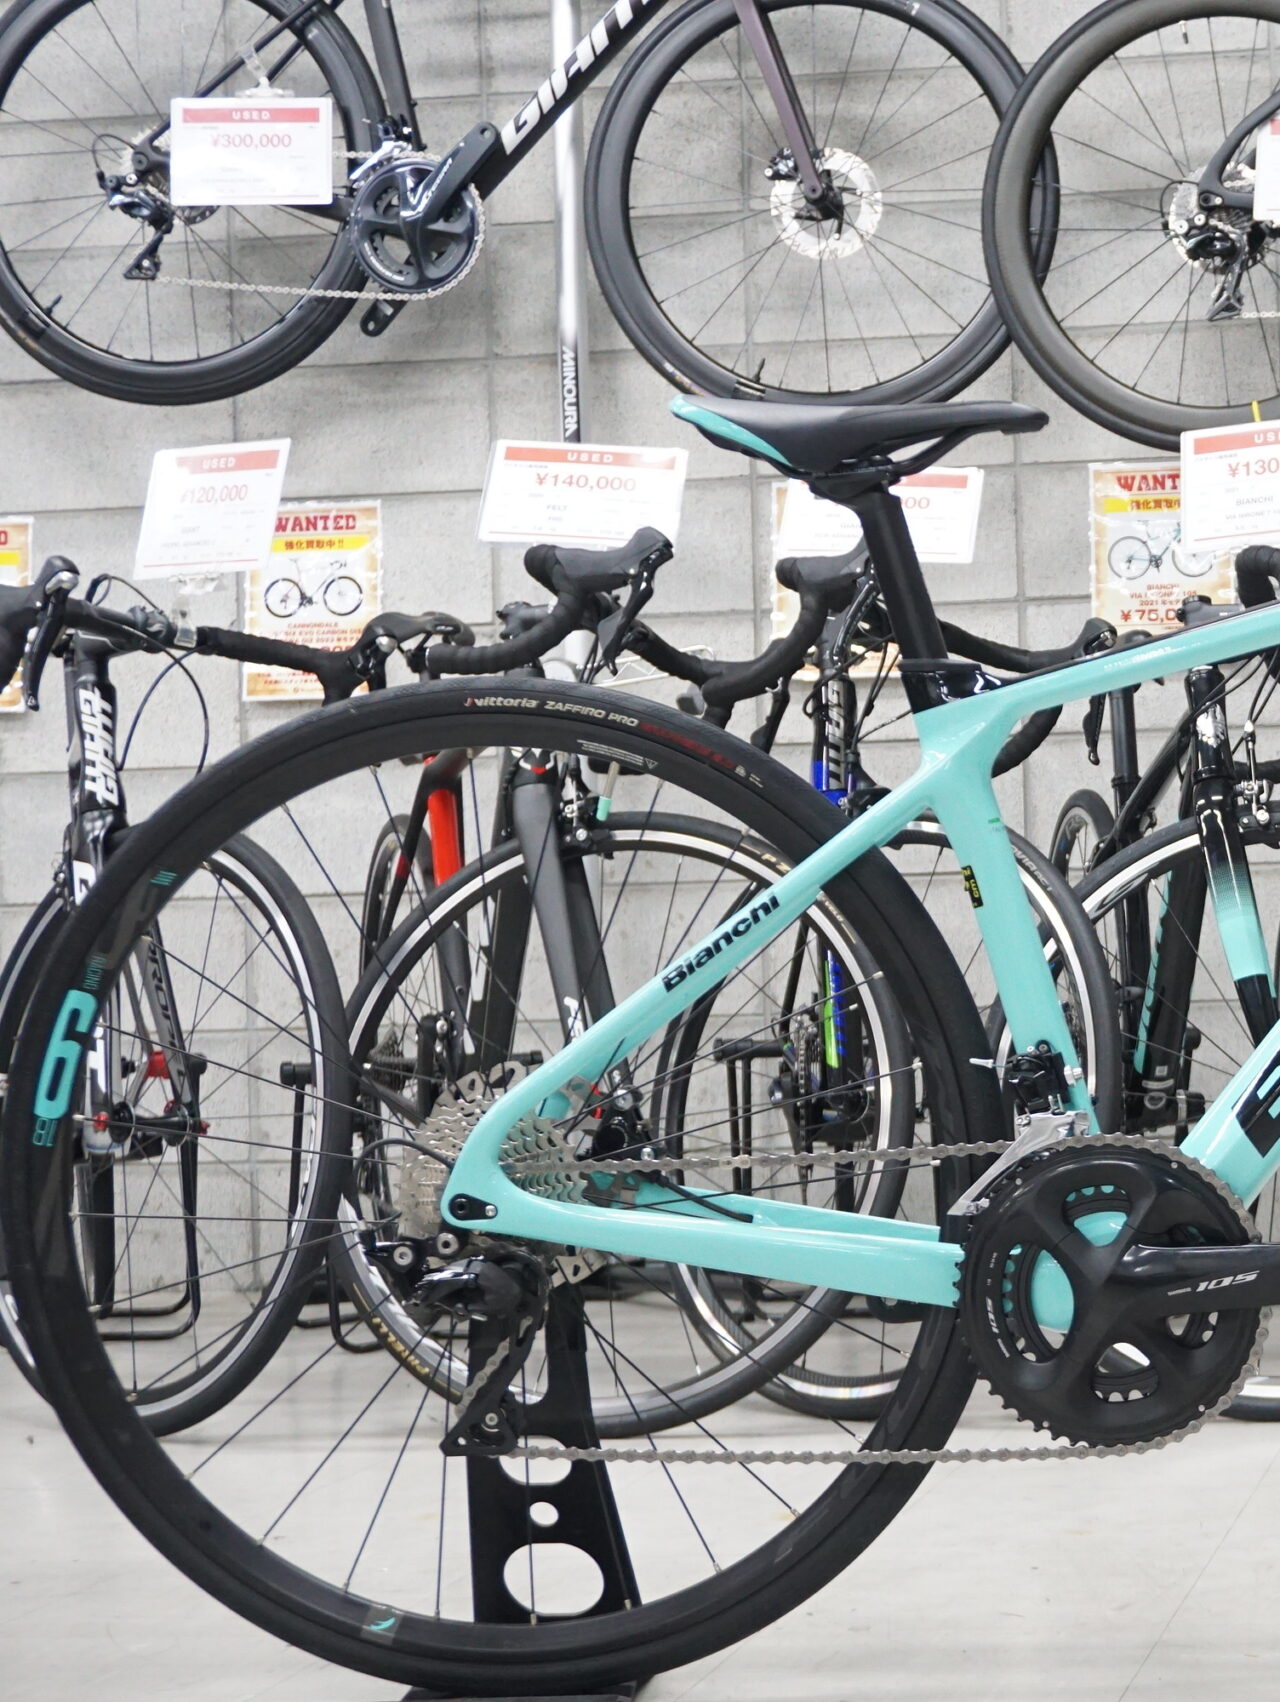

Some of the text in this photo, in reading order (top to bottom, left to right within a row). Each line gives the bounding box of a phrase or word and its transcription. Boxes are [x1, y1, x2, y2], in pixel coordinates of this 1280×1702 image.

[500, 0, 652, 156] GIAN
[231, 110, 271, 120] USED
[211, 134, 292, 150] ¥300,000
[562, 346, 578, 437] MINOURA
[202, 457, 237, 470] USED
[567, 452, 614, 464] USED
[536, 472, 636, 492] ¥140,000
[1116, 474, 1180, 492] WANT
[1235, 495, 1274, 506] BIANCHI
[275, 514, 357, 532] WANTED
[1121, 608, 1178, 623] ¥75,0
[543, 700, 606, 718] ZAFFIRO
[608, 712, 641, 727] PRO
[662, 895, 780, 994] Bianchi
[1195, 1270, 1260, 1293] 105
[986, 1296, 999, 1334] 105
